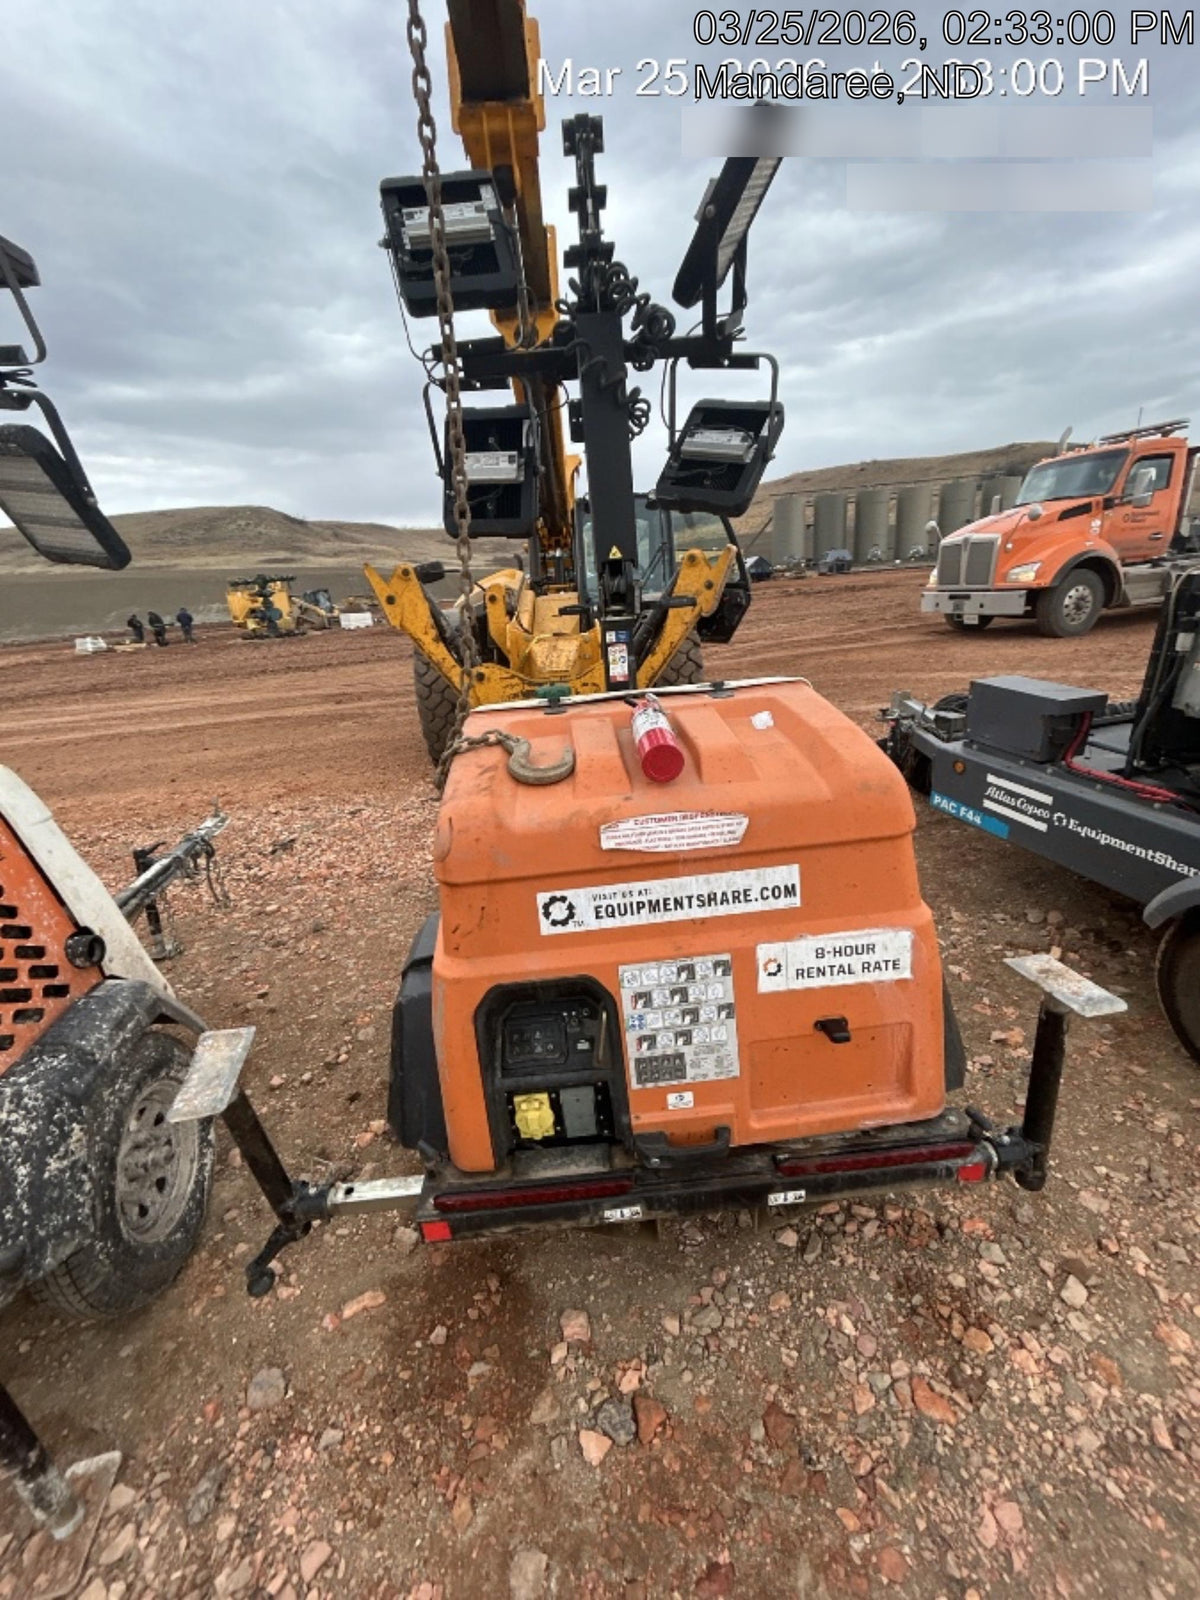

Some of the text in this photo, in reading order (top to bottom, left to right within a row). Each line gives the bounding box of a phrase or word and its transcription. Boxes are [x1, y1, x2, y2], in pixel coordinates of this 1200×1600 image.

[933, 794, 958, 813] PAC
[592, 892, 617, 902] VISIT
[594, 883, 797, 920] EQUIPMENTSHARE.COM
[815, 943, 876, 959] 8-HOUR
[796, 958, 901, 980] RENTAL RATE
